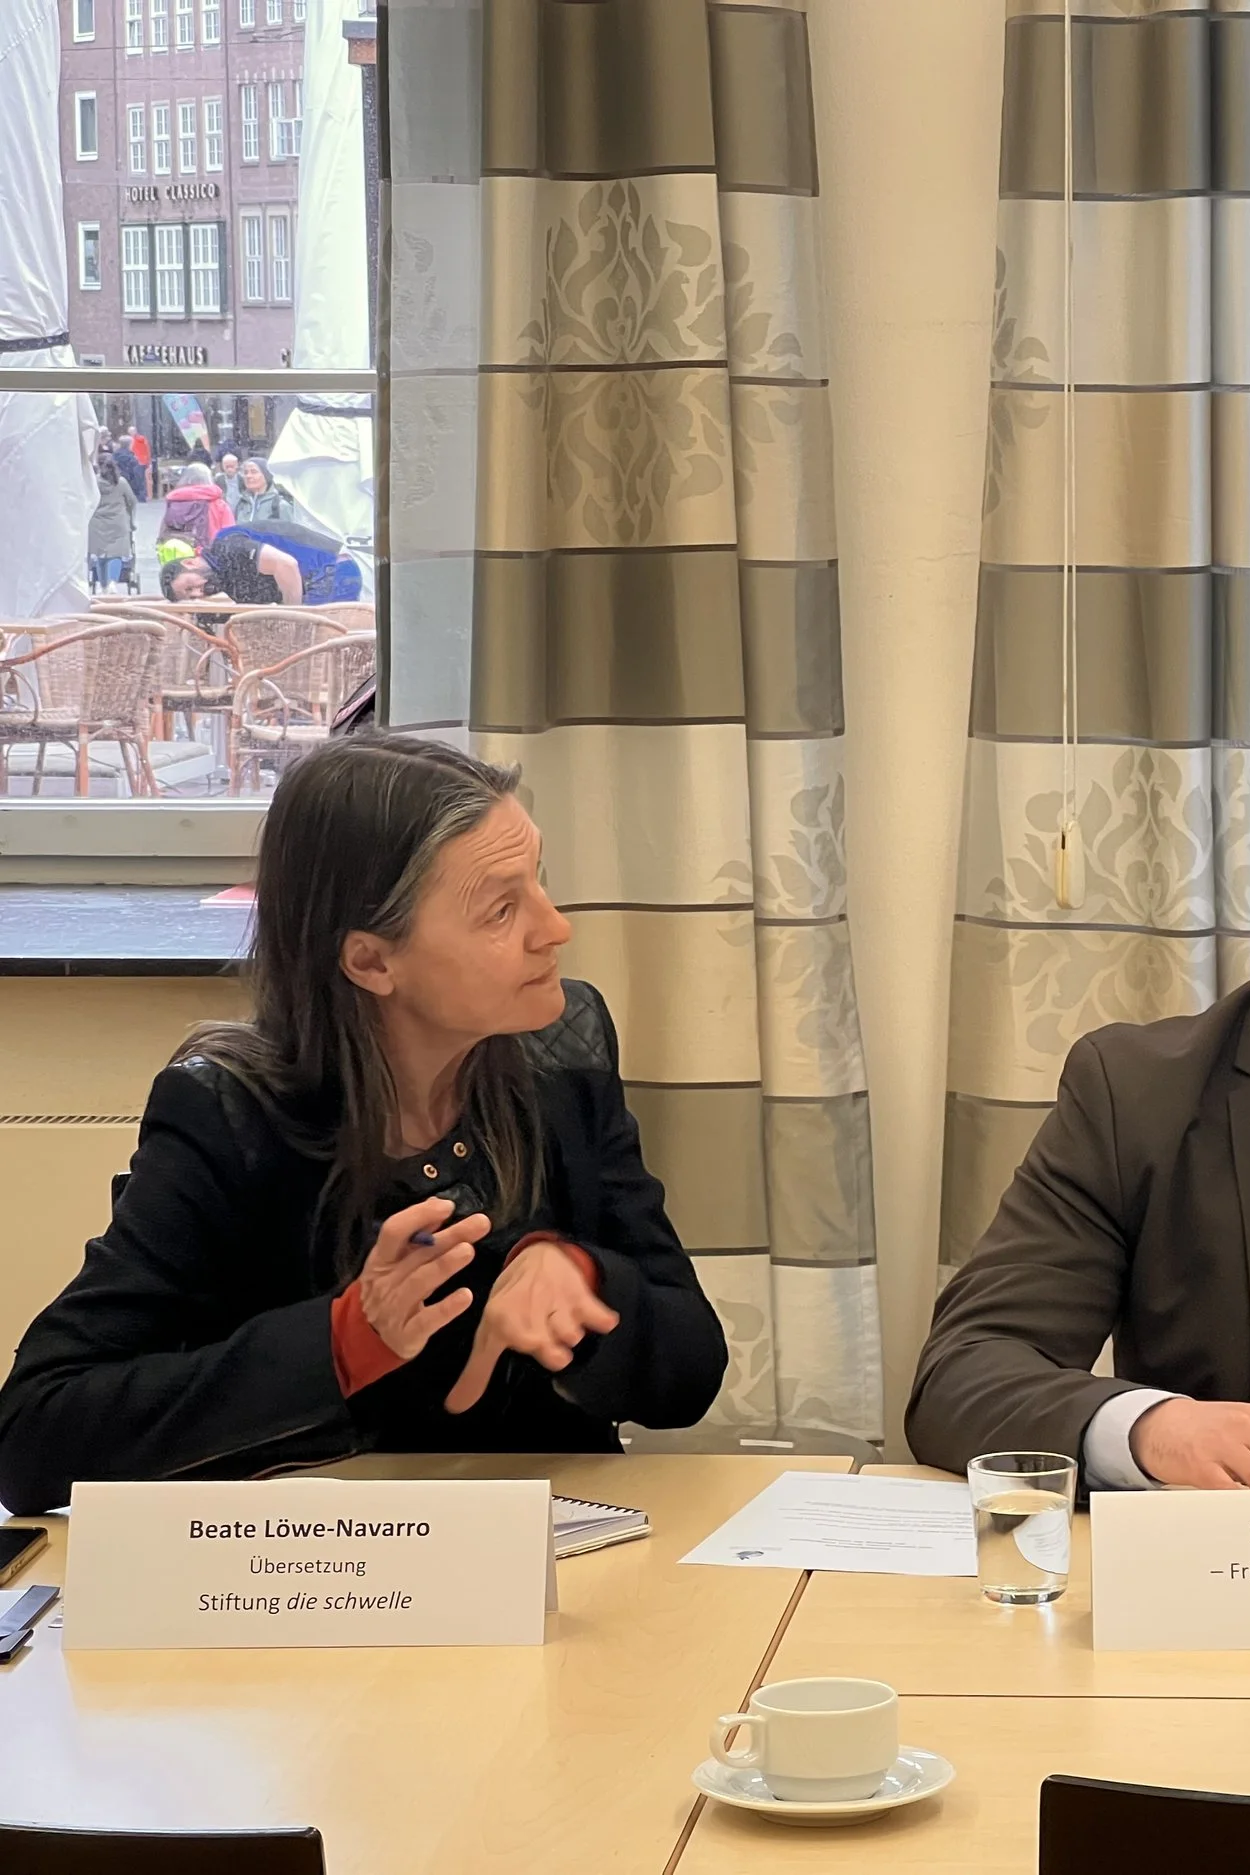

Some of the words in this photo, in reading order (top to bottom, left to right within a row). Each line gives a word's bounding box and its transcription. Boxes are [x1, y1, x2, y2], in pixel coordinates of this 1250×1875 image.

[125, 186, 157, 202] HOTEL
[164, 183, 217, 201] CLASSICO
[189, 1520, 257, 1539] Beate
[264, 1518, 431, 1539] Löwe-Navarro
[250, 1555, 367, 1577] Übersetzung
[198, 1592, 281, 1615] Stiftung
[286, 1591, 318, 1610] die
[322, 1590, 413, 1610] schwelle
